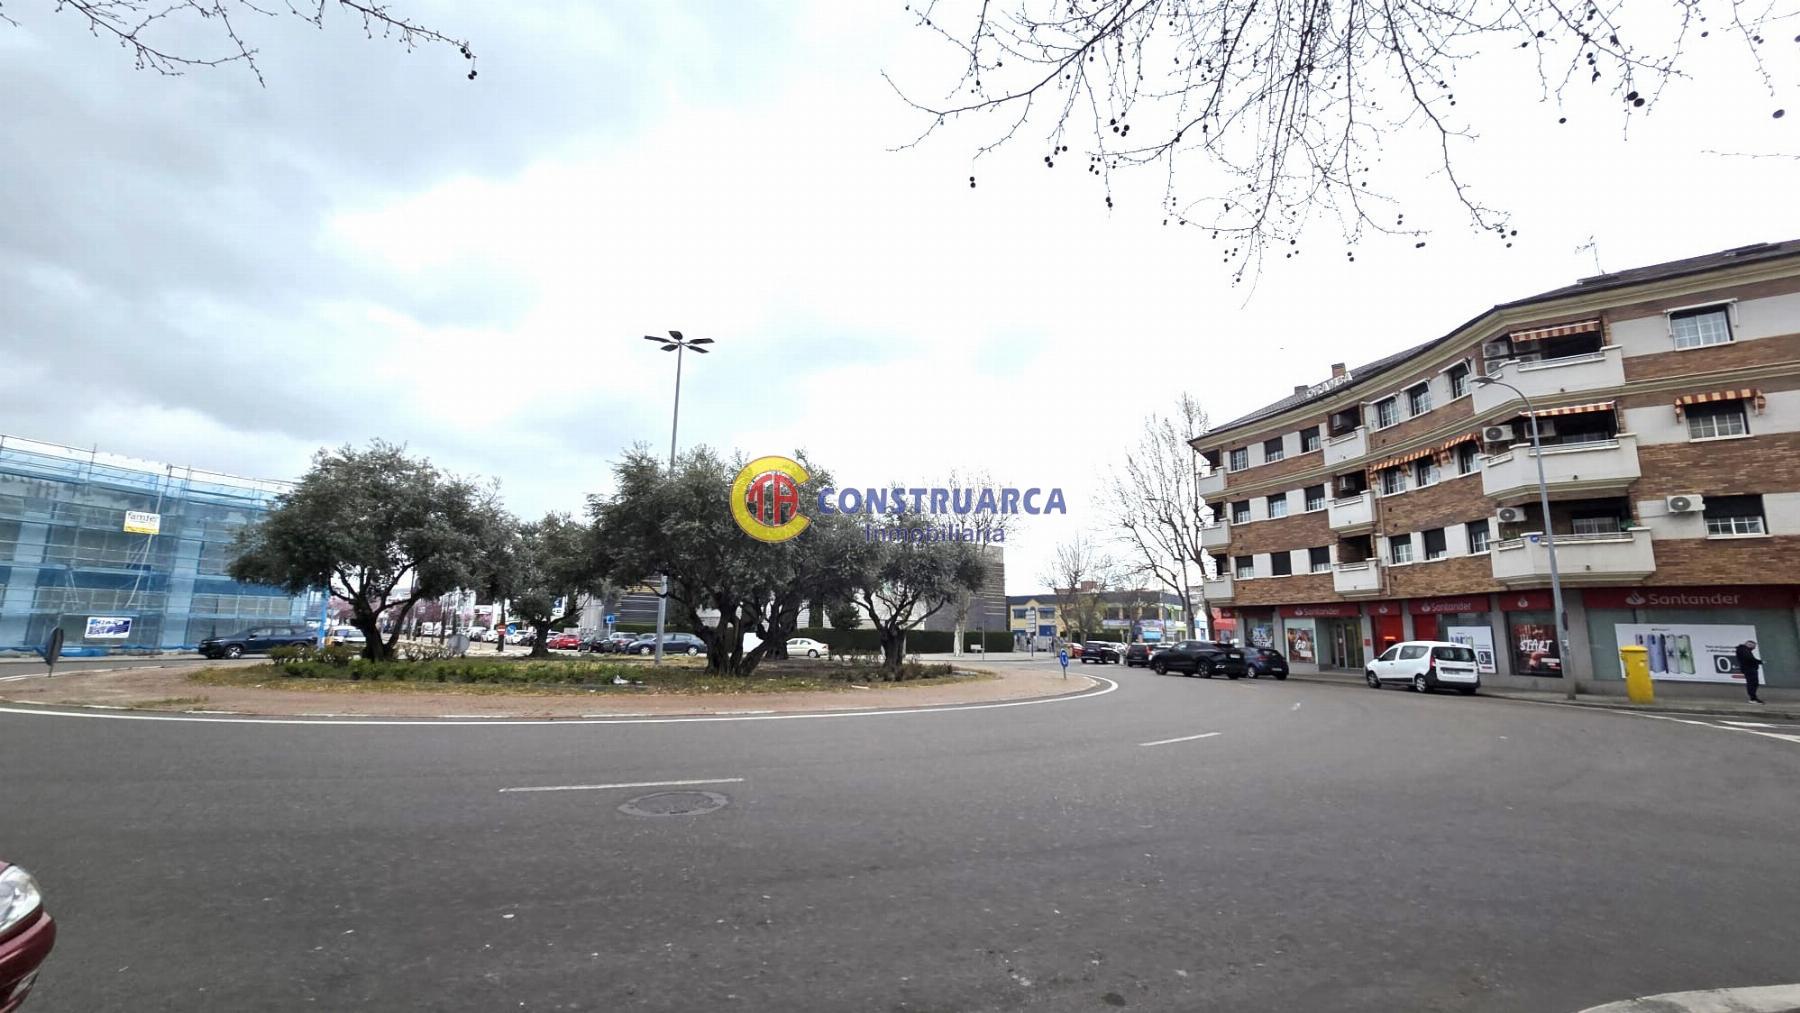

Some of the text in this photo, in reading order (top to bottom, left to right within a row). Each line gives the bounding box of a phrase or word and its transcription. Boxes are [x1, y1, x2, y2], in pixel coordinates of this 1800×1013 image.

[1648, 593, 1740, 605] Santander
[1431, 600, 1472, 612] Santander
[1519, 638, 1553, 652] START
